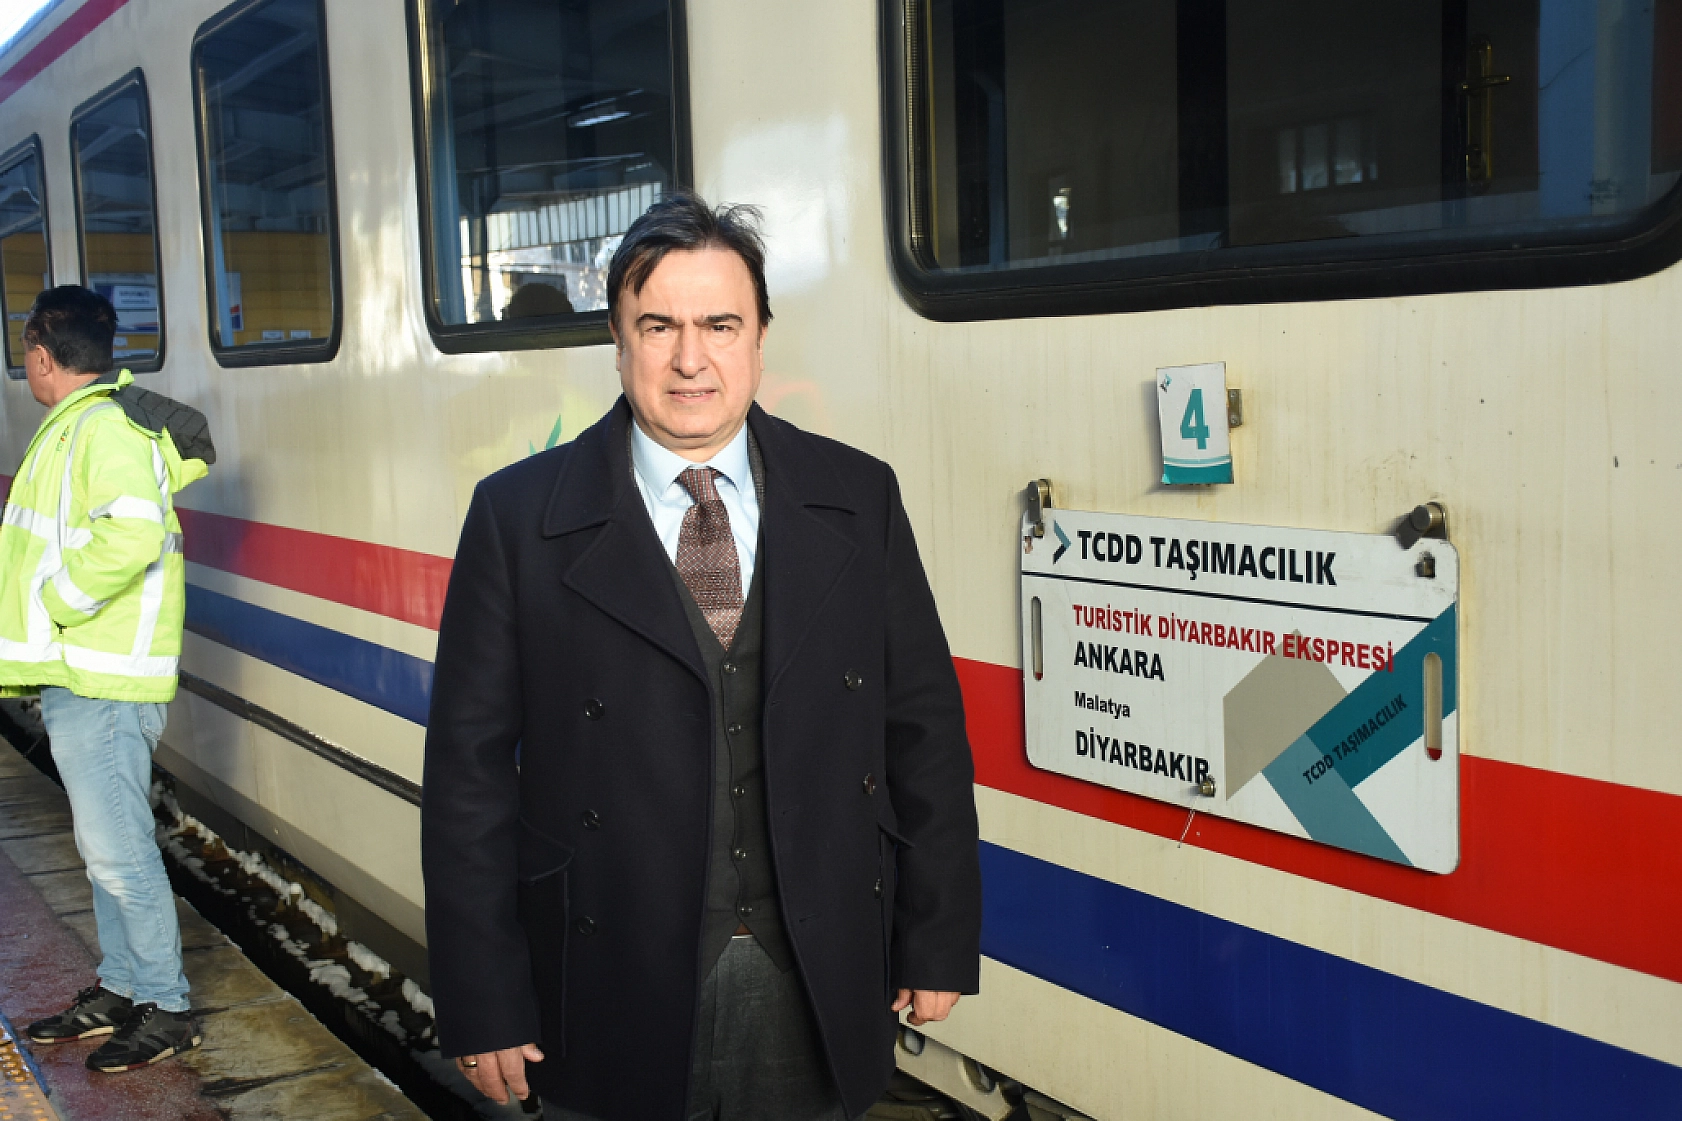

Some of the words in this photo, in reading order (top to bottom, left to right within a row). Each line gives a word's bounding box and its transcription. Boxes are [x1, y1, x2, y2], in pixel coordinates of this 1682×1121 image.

[1180, 389, 1210, 449] 4
[1077, 530, 1143, 565] TCDD
[1150, 535, 1337, 586] TAŞIMACILIK
[1073, 604, 1153, 636] TURİSTİK
[1158, 612, 1277, 655] DİYARBAKIR
[1282, 633, 1394, 673] EKSPRESİ
[1073, 641, 1165, 681] ANKARA
[1074, 690, 1131, 719] Malatya
[1075, 726, 1209, 785] DİYARBAKIR
[1302, 754, 1334, 785] TCDD
[1332, 693, 1407, 760] TAŞIMACILIK
